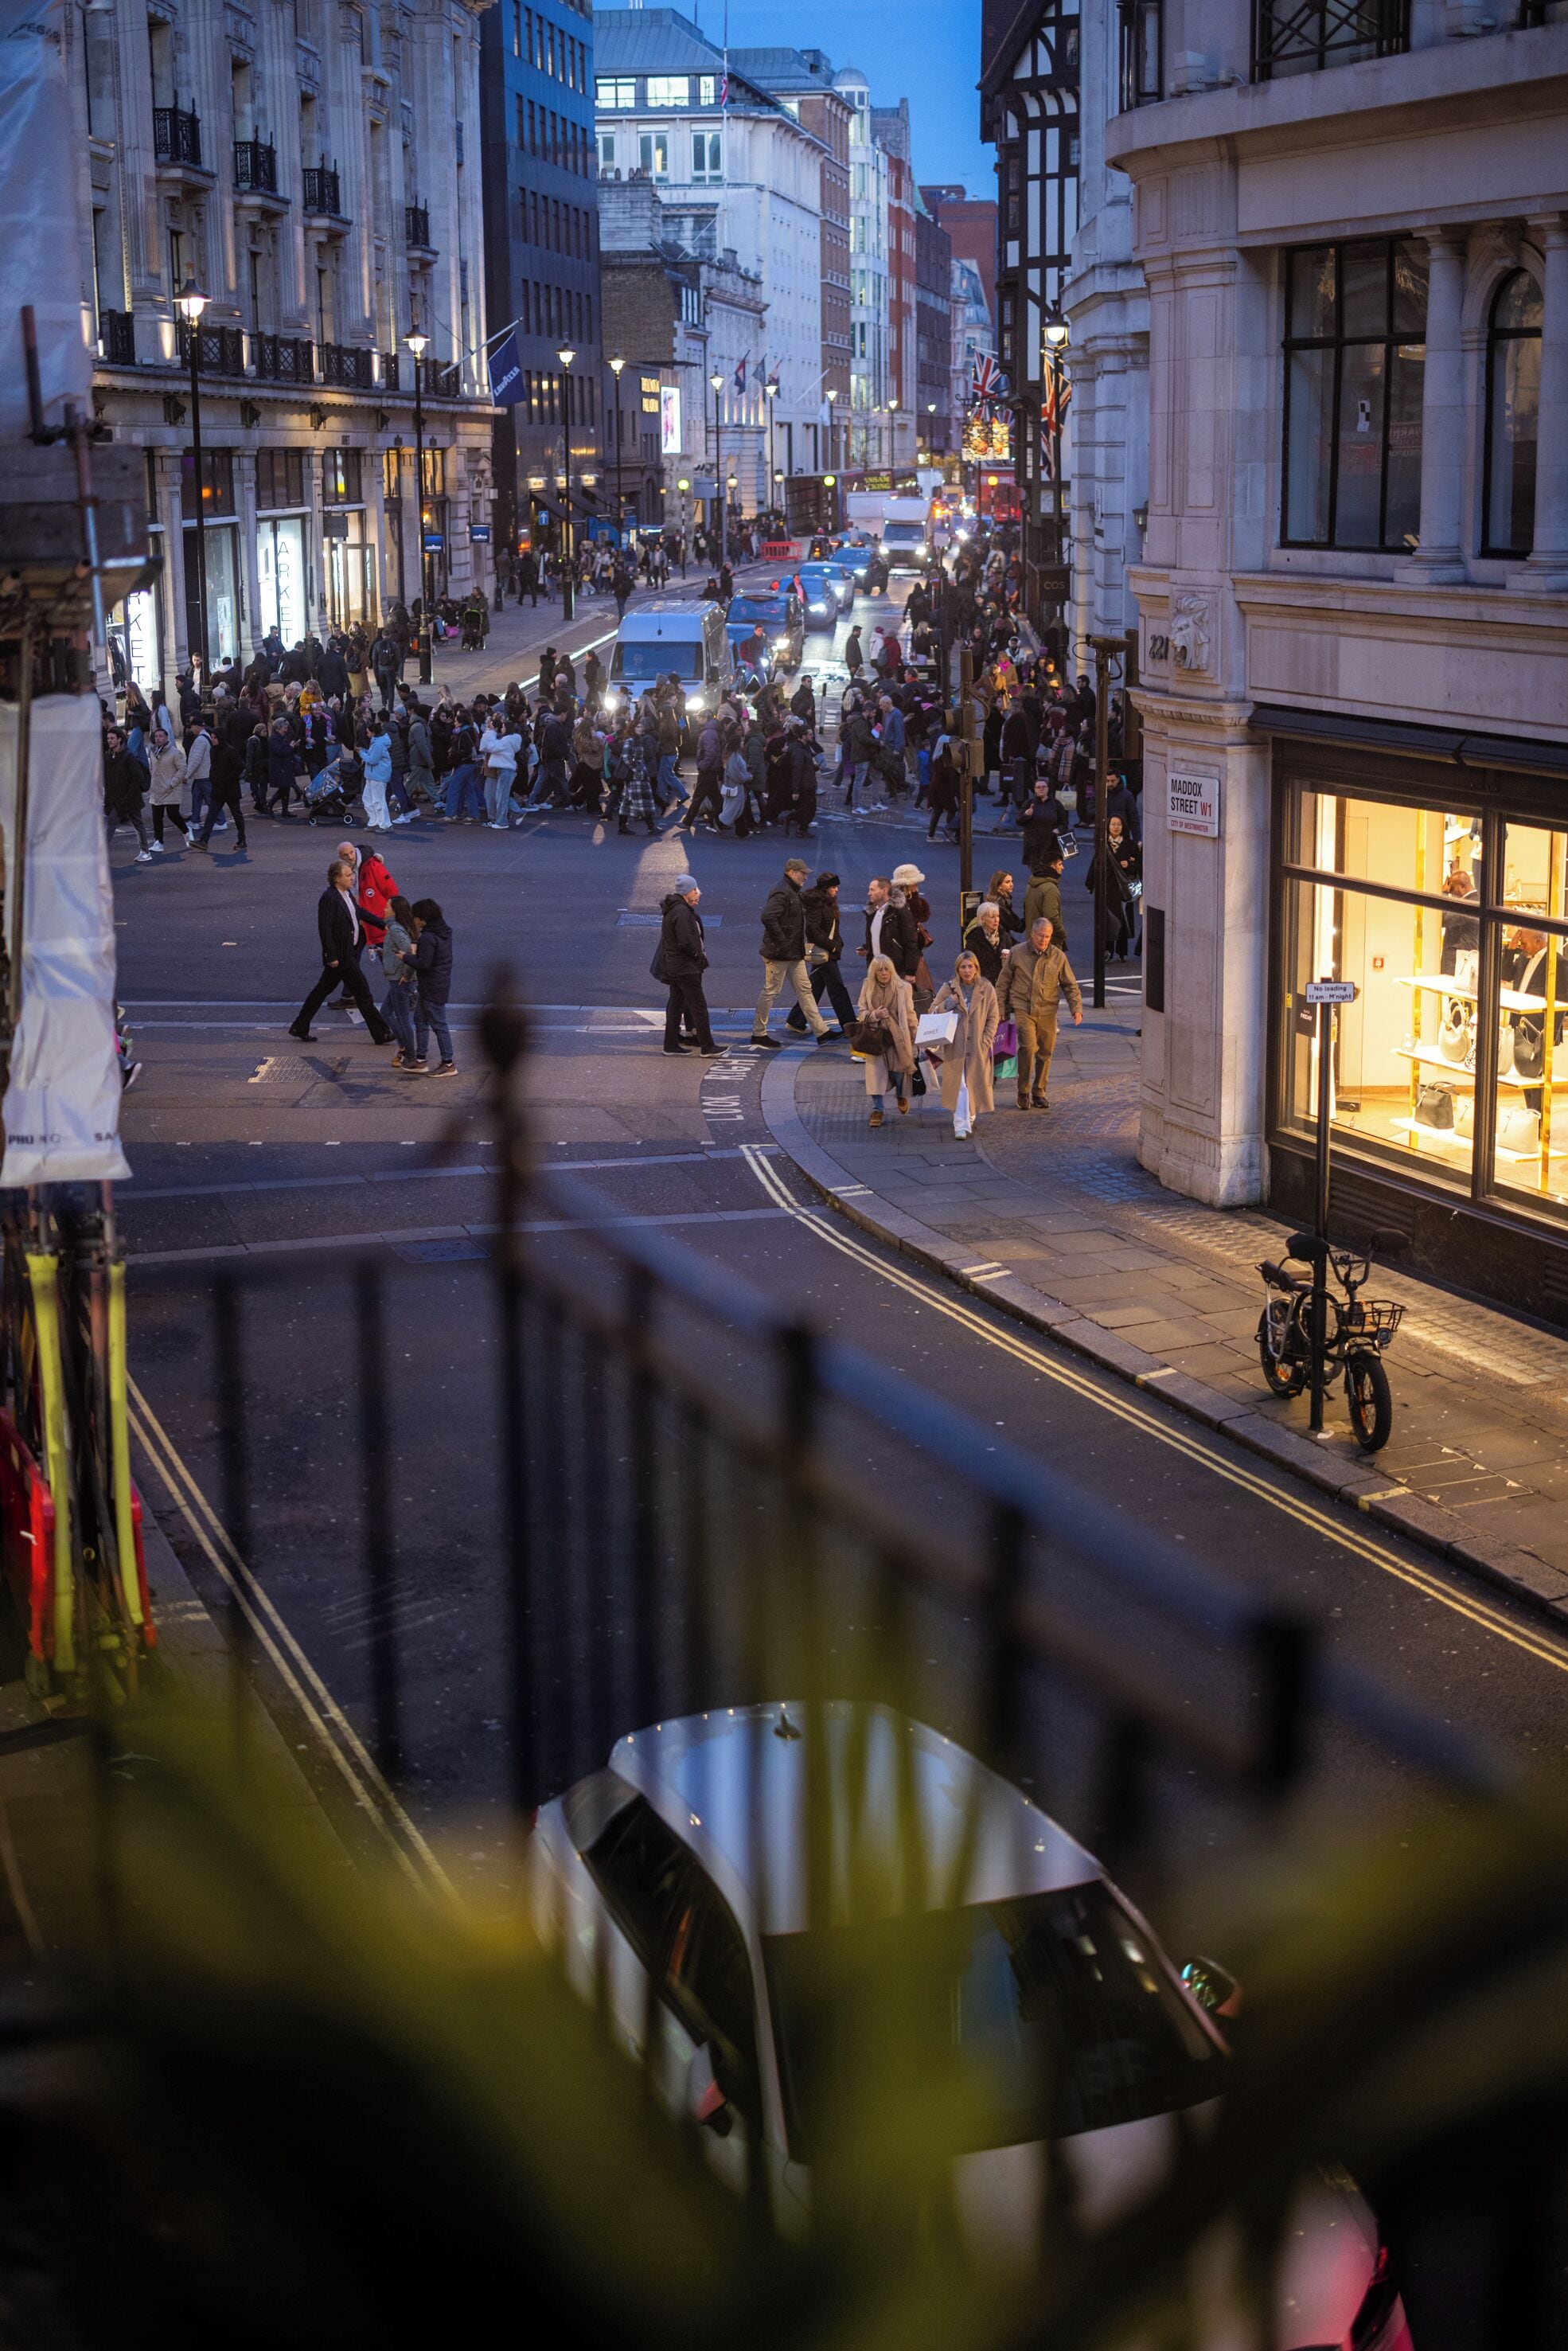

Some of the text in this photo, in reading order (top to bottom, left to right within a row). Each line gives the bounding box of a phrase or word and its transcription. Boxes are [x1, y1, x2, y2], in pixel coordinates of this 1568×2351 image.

[493, 366, 521, 396] LAVAZZA
[278, 541, 292, 642] ARKET
[1043, 580, 1065, 590] COS
[128, 592, 146, 684] RKET
[1171, 779, 1203, 798] MADDOX
[1171, 796, 1212, 817] STREET W1
[1300, 1013, 1313, 1021] FRIDAY
[700, 1052, 762, 1121] LOOK RIGHT
